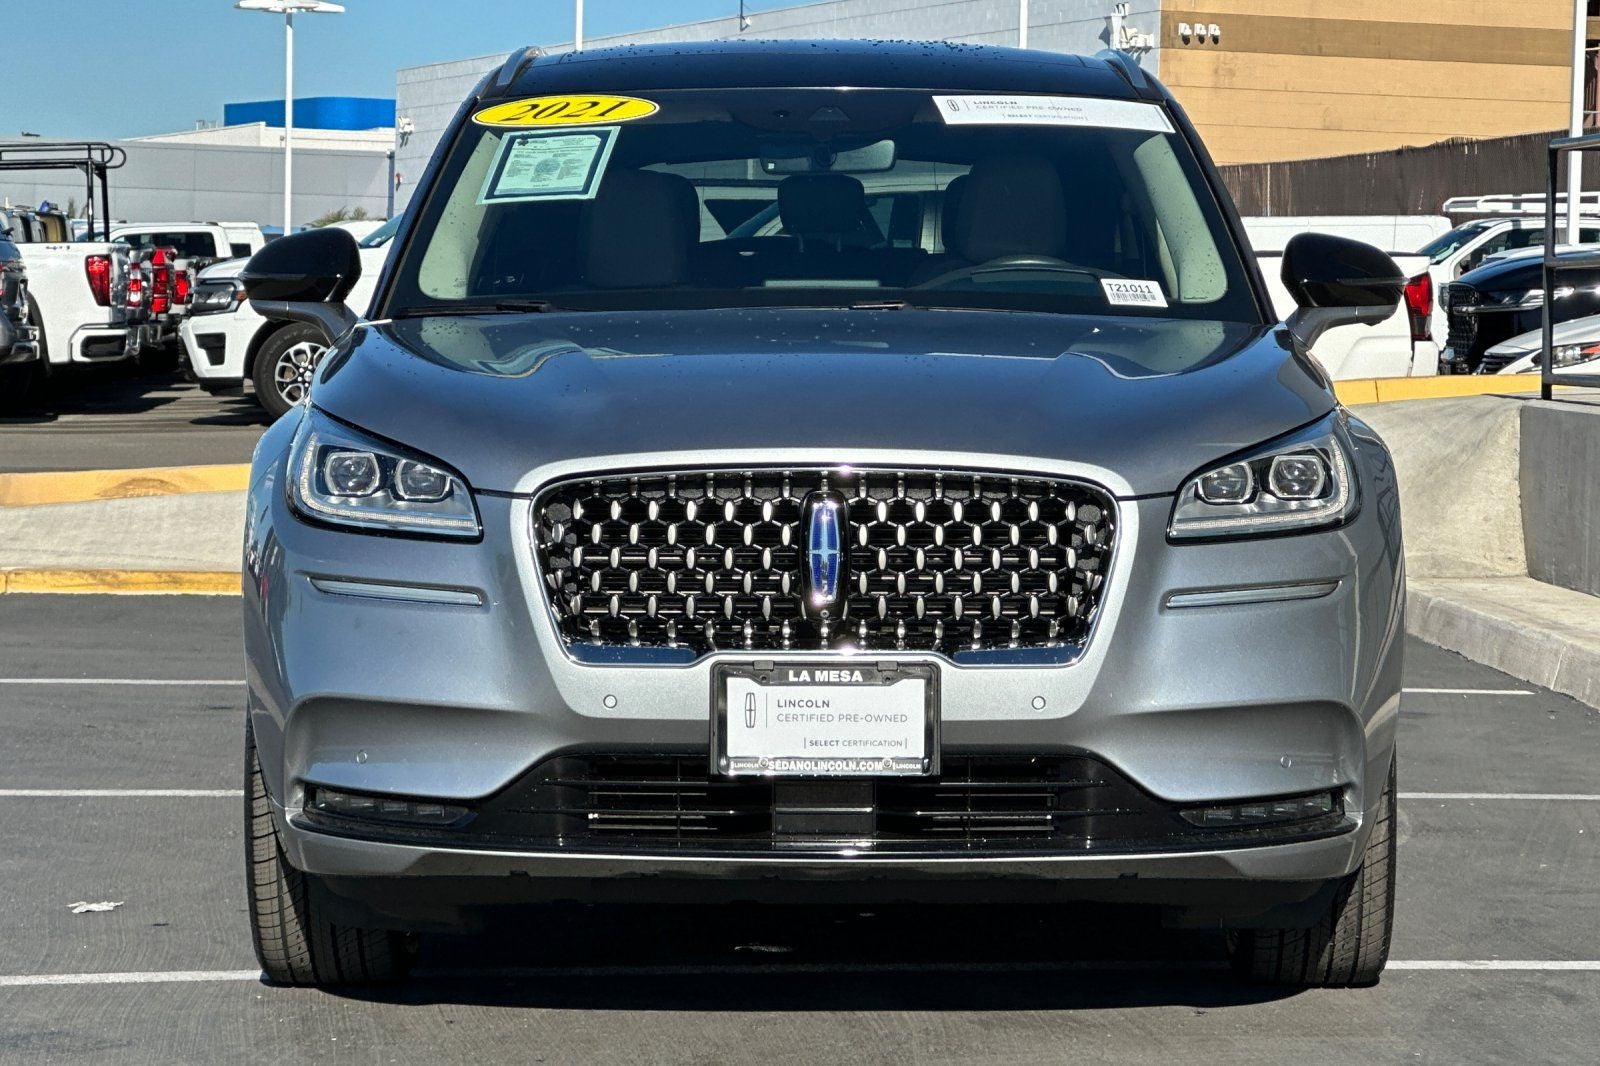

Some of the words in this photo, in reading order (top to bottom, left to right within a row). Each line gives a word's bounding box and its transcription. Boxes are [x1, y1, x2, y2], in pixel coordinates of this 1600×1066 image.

[500, 100, 630, 122] 2021
[1106, 283, 1153, 294] T21011
[788, 670, 810, 682] LA
[815, 670, 863, 682] MESA
[777, 699, 830, 708] LINCOLN
[777, 713, 834, 723] CERTIFIED
[838, 713, 908, 723] PRE-OWNED
[809, 739, 840, 747] SELECT
[842, 739, 902, 747] CERTIFICATION
[768, 760, 883, 771] SEDANOLINCOLN.COM
